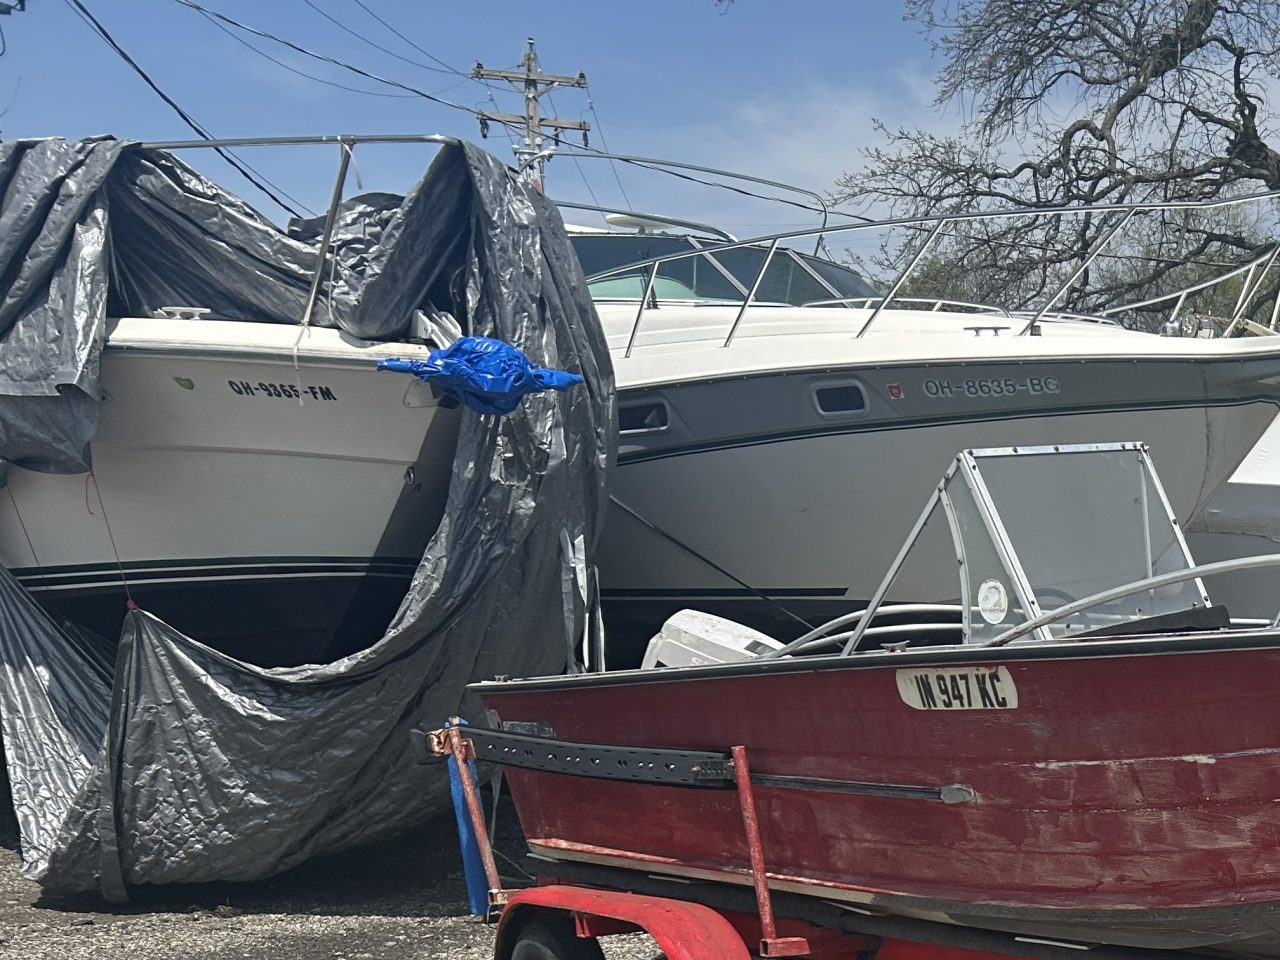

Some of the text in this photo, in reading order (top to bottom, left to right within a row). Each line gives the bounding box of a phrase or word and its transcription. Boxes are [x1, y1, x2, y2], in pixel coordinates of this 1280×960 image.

[925, 377, 1060, 398] OH-8635-BG
[914, 672, 1007, 709] IN 947 KC
